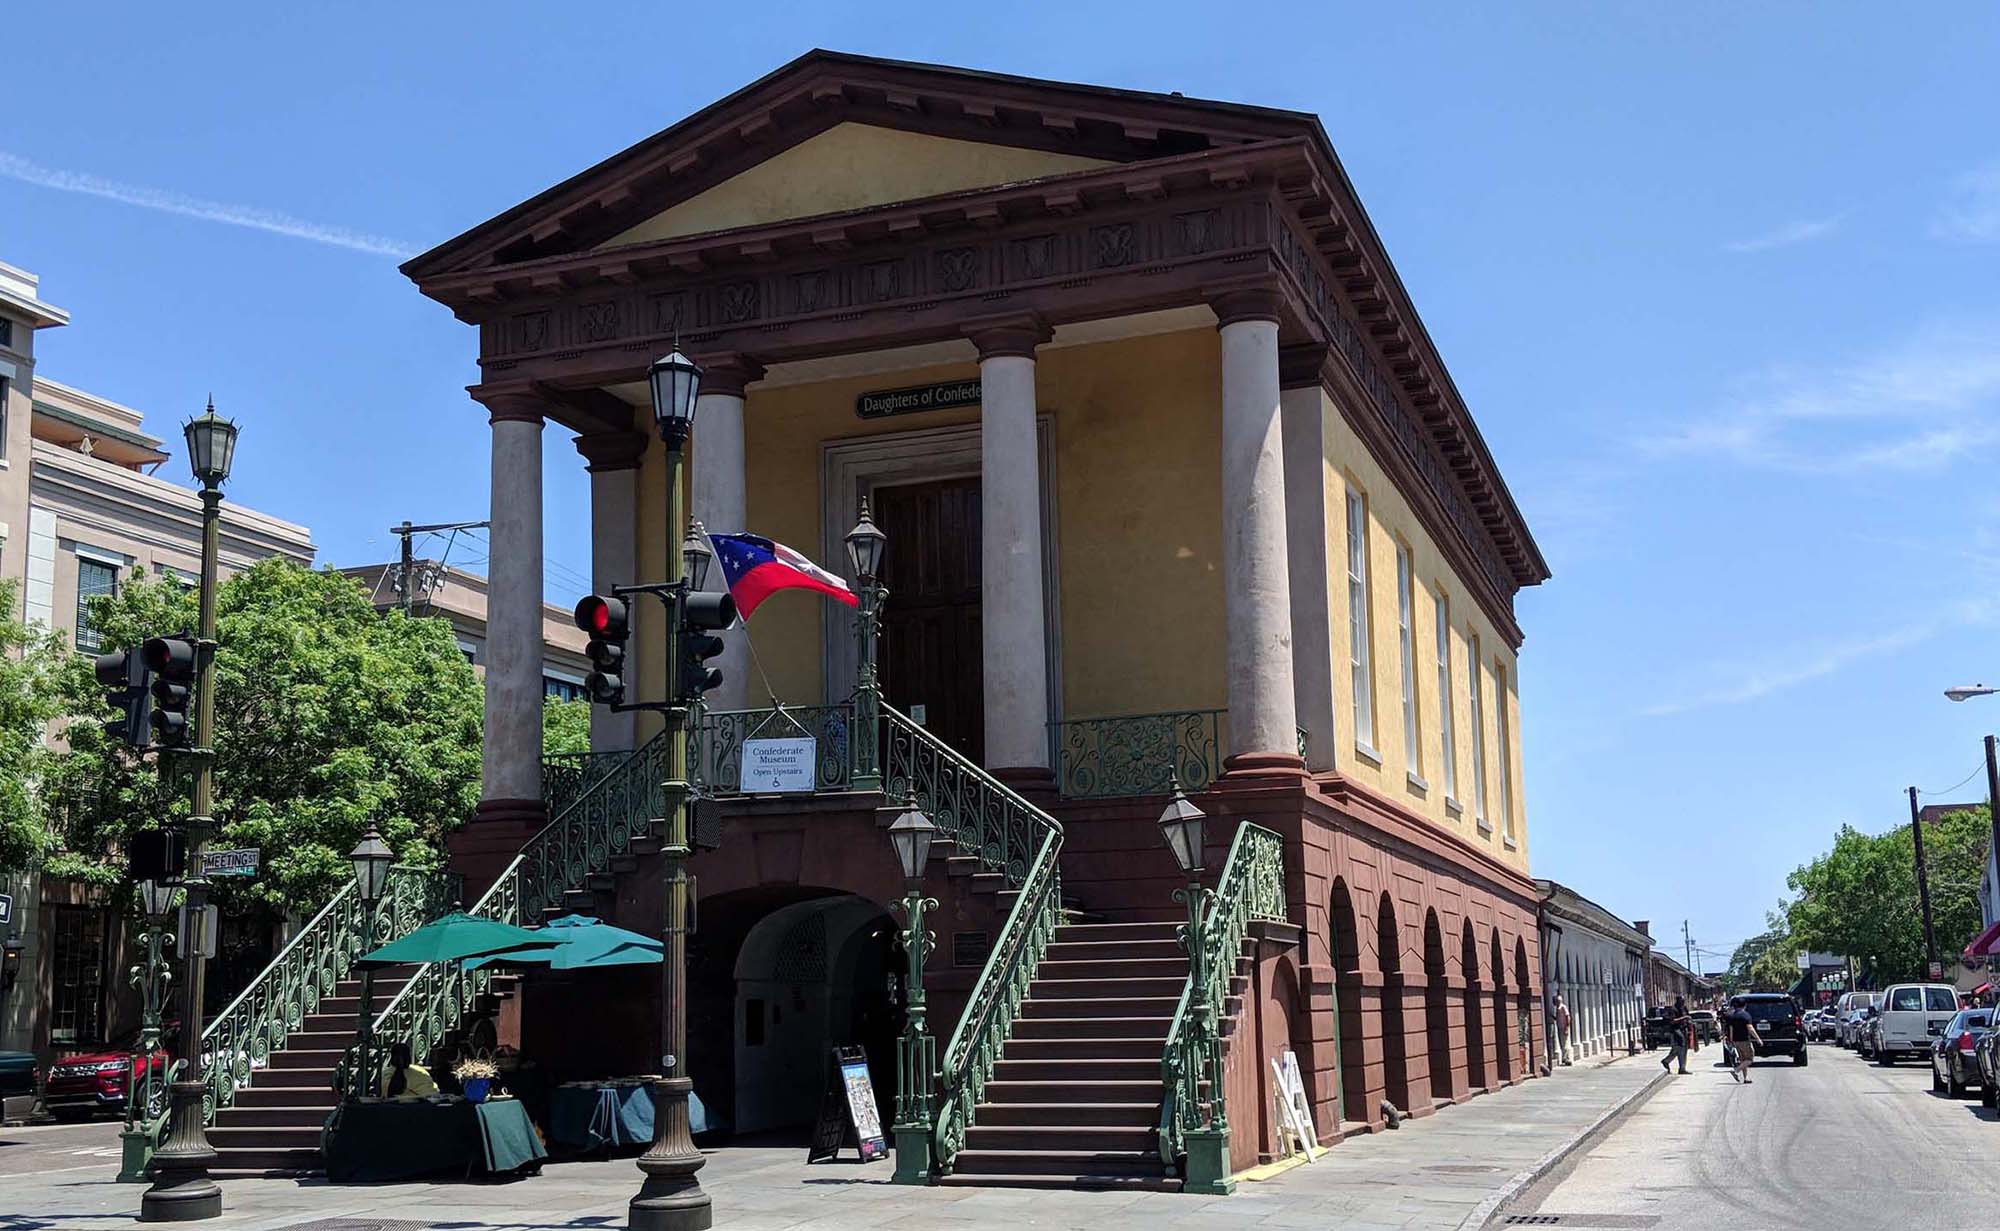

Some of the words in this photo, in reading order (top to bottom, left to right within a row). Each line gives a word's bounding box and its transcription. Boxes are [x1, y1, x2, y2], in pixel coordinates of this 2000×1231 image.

[863, 393, 918, 413] Daughters
[921, 388, 933, 404] of
[752, 747, 804, 756] Confederate
[773, 768, 803, 776] Upstairs
[208, 854, 248, 867] MEETING
[248, 854, 257, 863] ST
